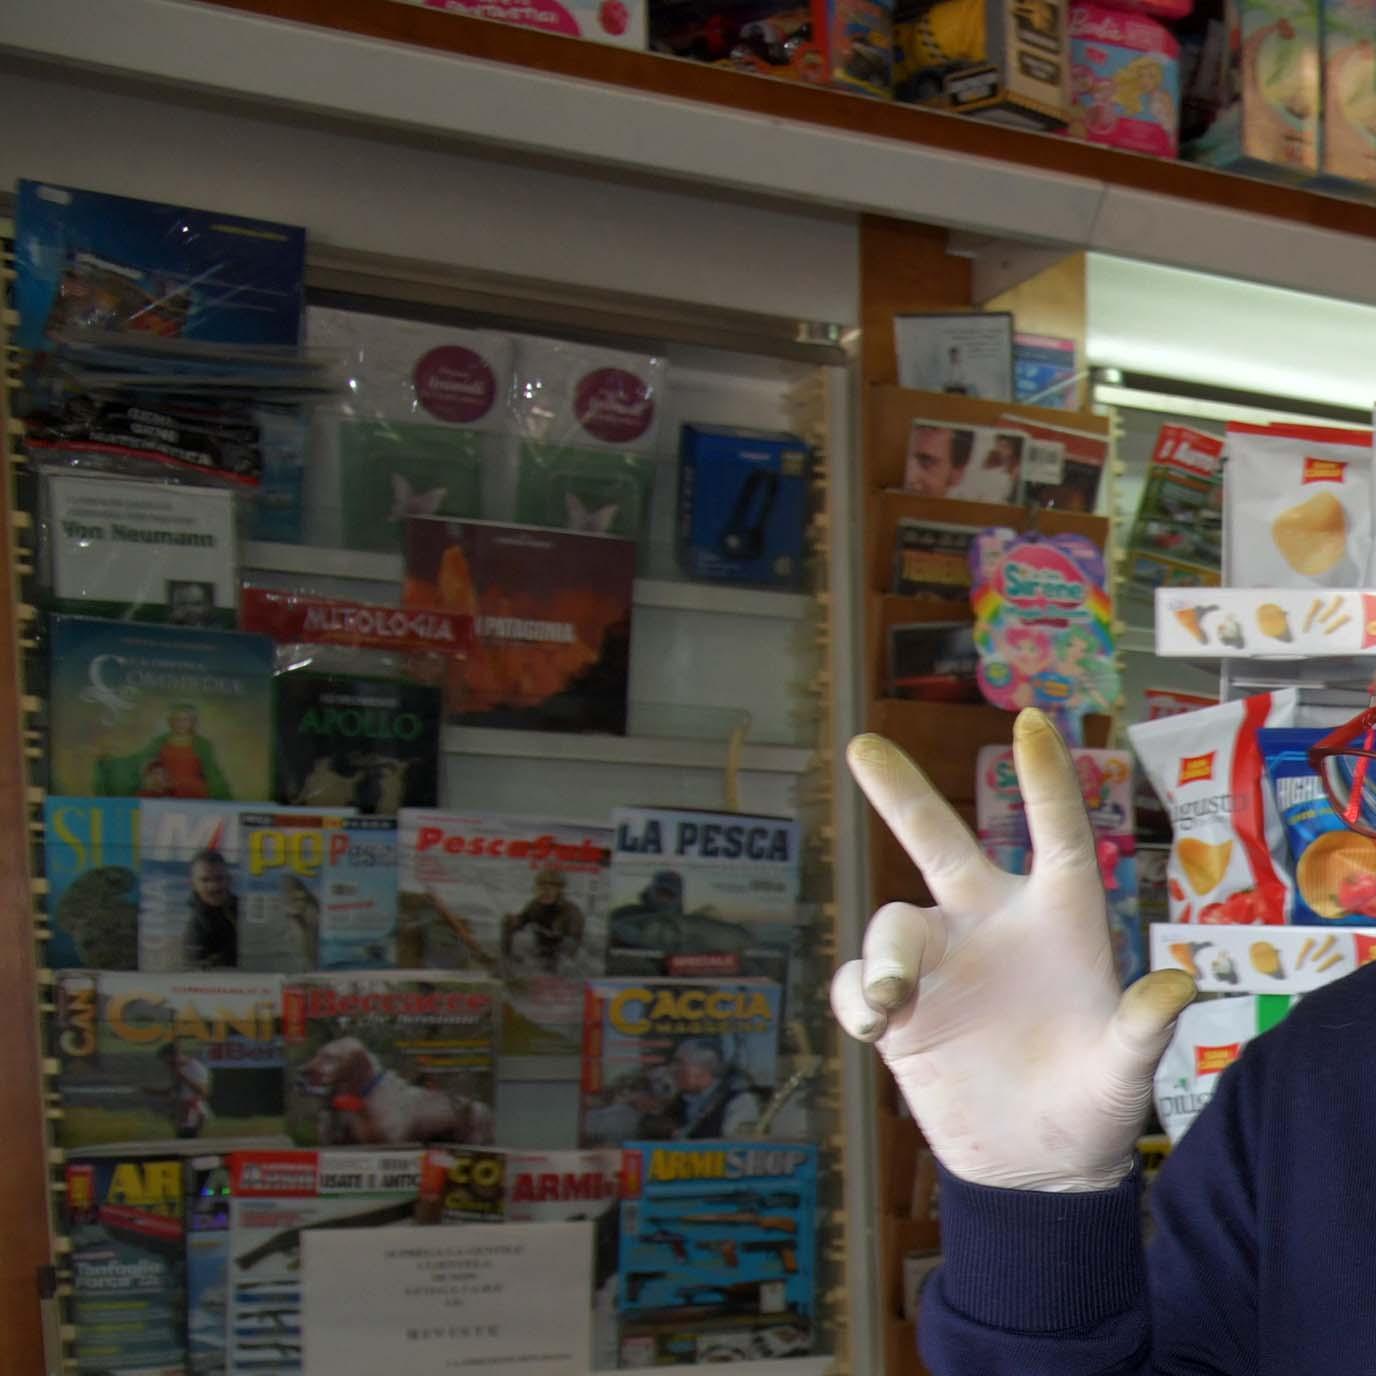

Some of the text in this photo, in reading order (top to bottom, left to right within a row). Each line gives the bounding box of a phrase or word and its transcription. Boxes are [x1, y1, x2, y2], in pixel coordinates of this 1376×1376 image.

[113, 524, 216, 548] Neumann
[303, 606, 456, 641] MITOLOGIA
[617, 820, 663, 855] LA
[675, 823, 790, 862] PESCA
[609, 988, 771, 1035] CACCIA
